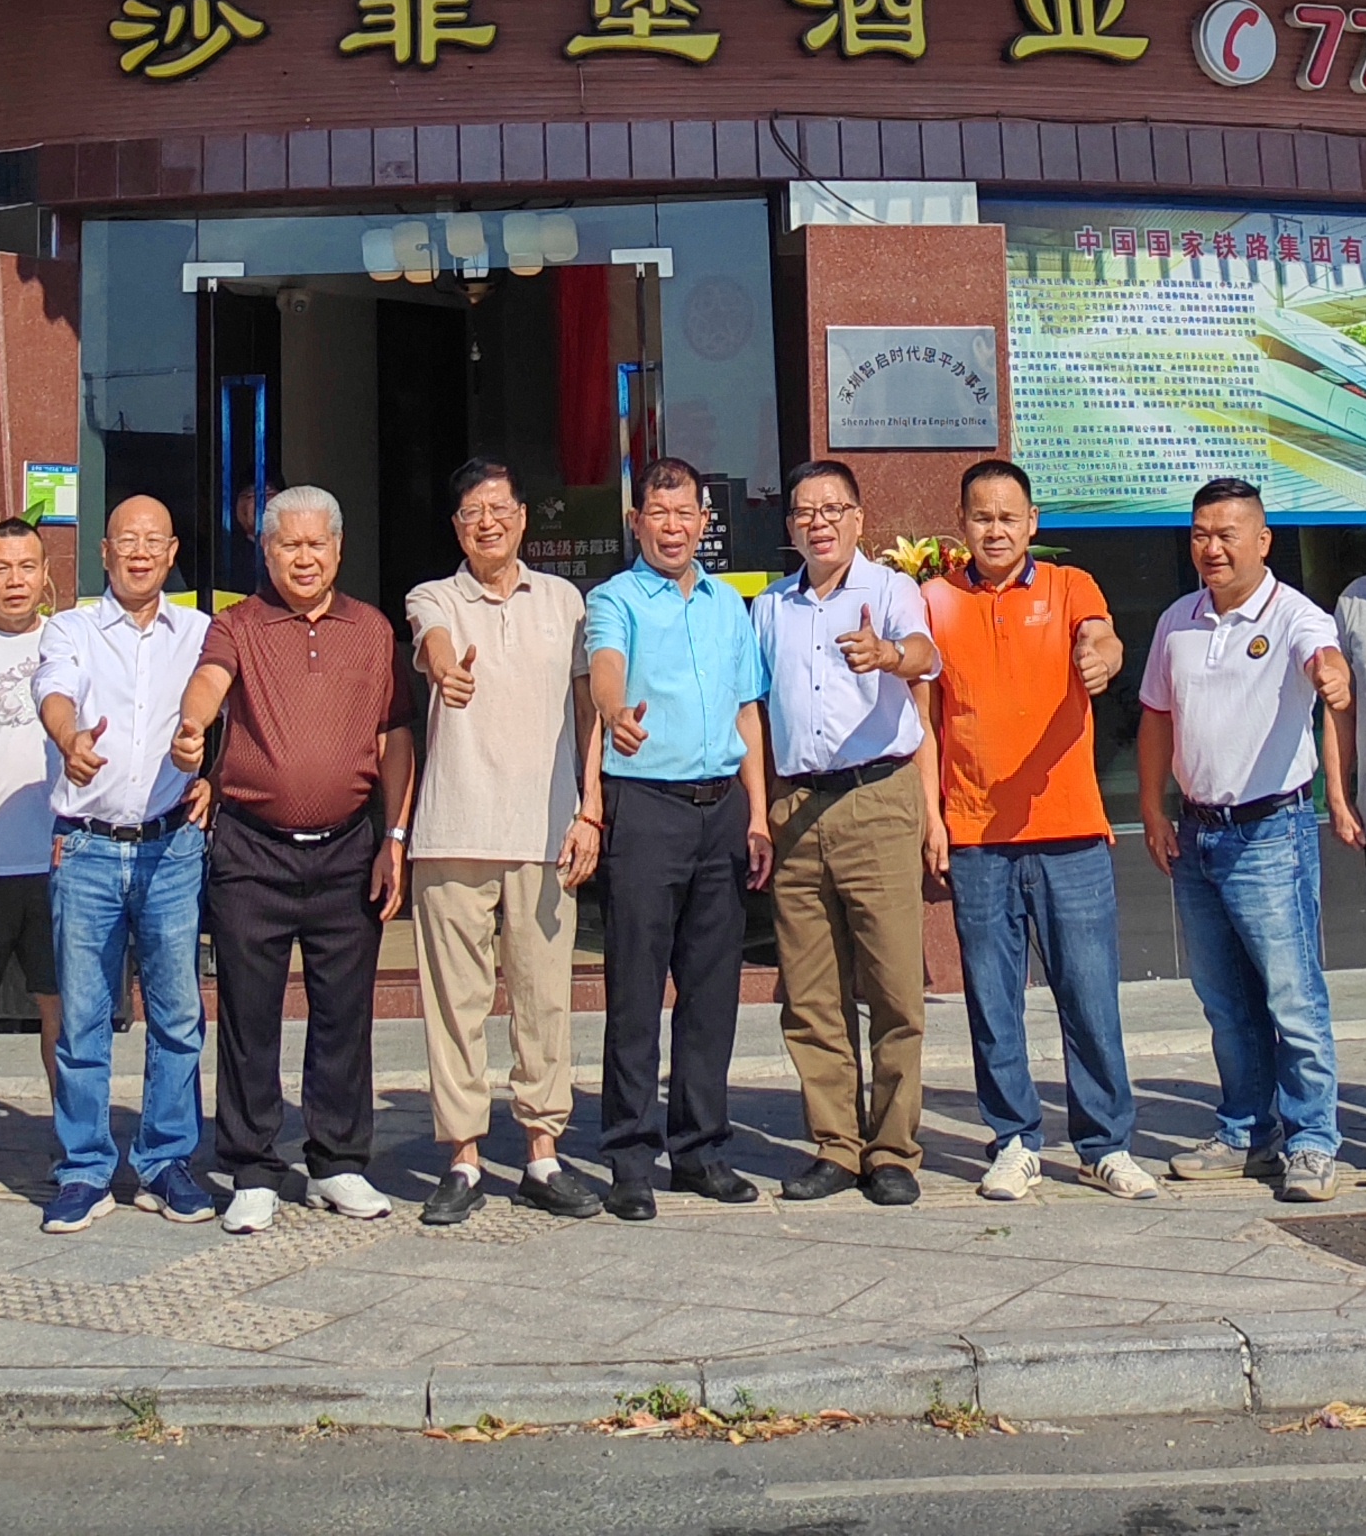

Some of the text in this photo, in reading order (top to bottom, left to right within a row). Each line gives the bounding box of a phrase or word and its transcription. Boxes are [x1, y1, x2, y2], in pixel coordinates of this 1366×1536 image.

[837, 345, 990, 405] 深圳智启时代恩平办事处
[841, 417, 886, 427] Shenzhen
[912, 417, 928, 427] Era
[928, 417, 960, 428] Enping
[961, 417, 987, 426] Office
